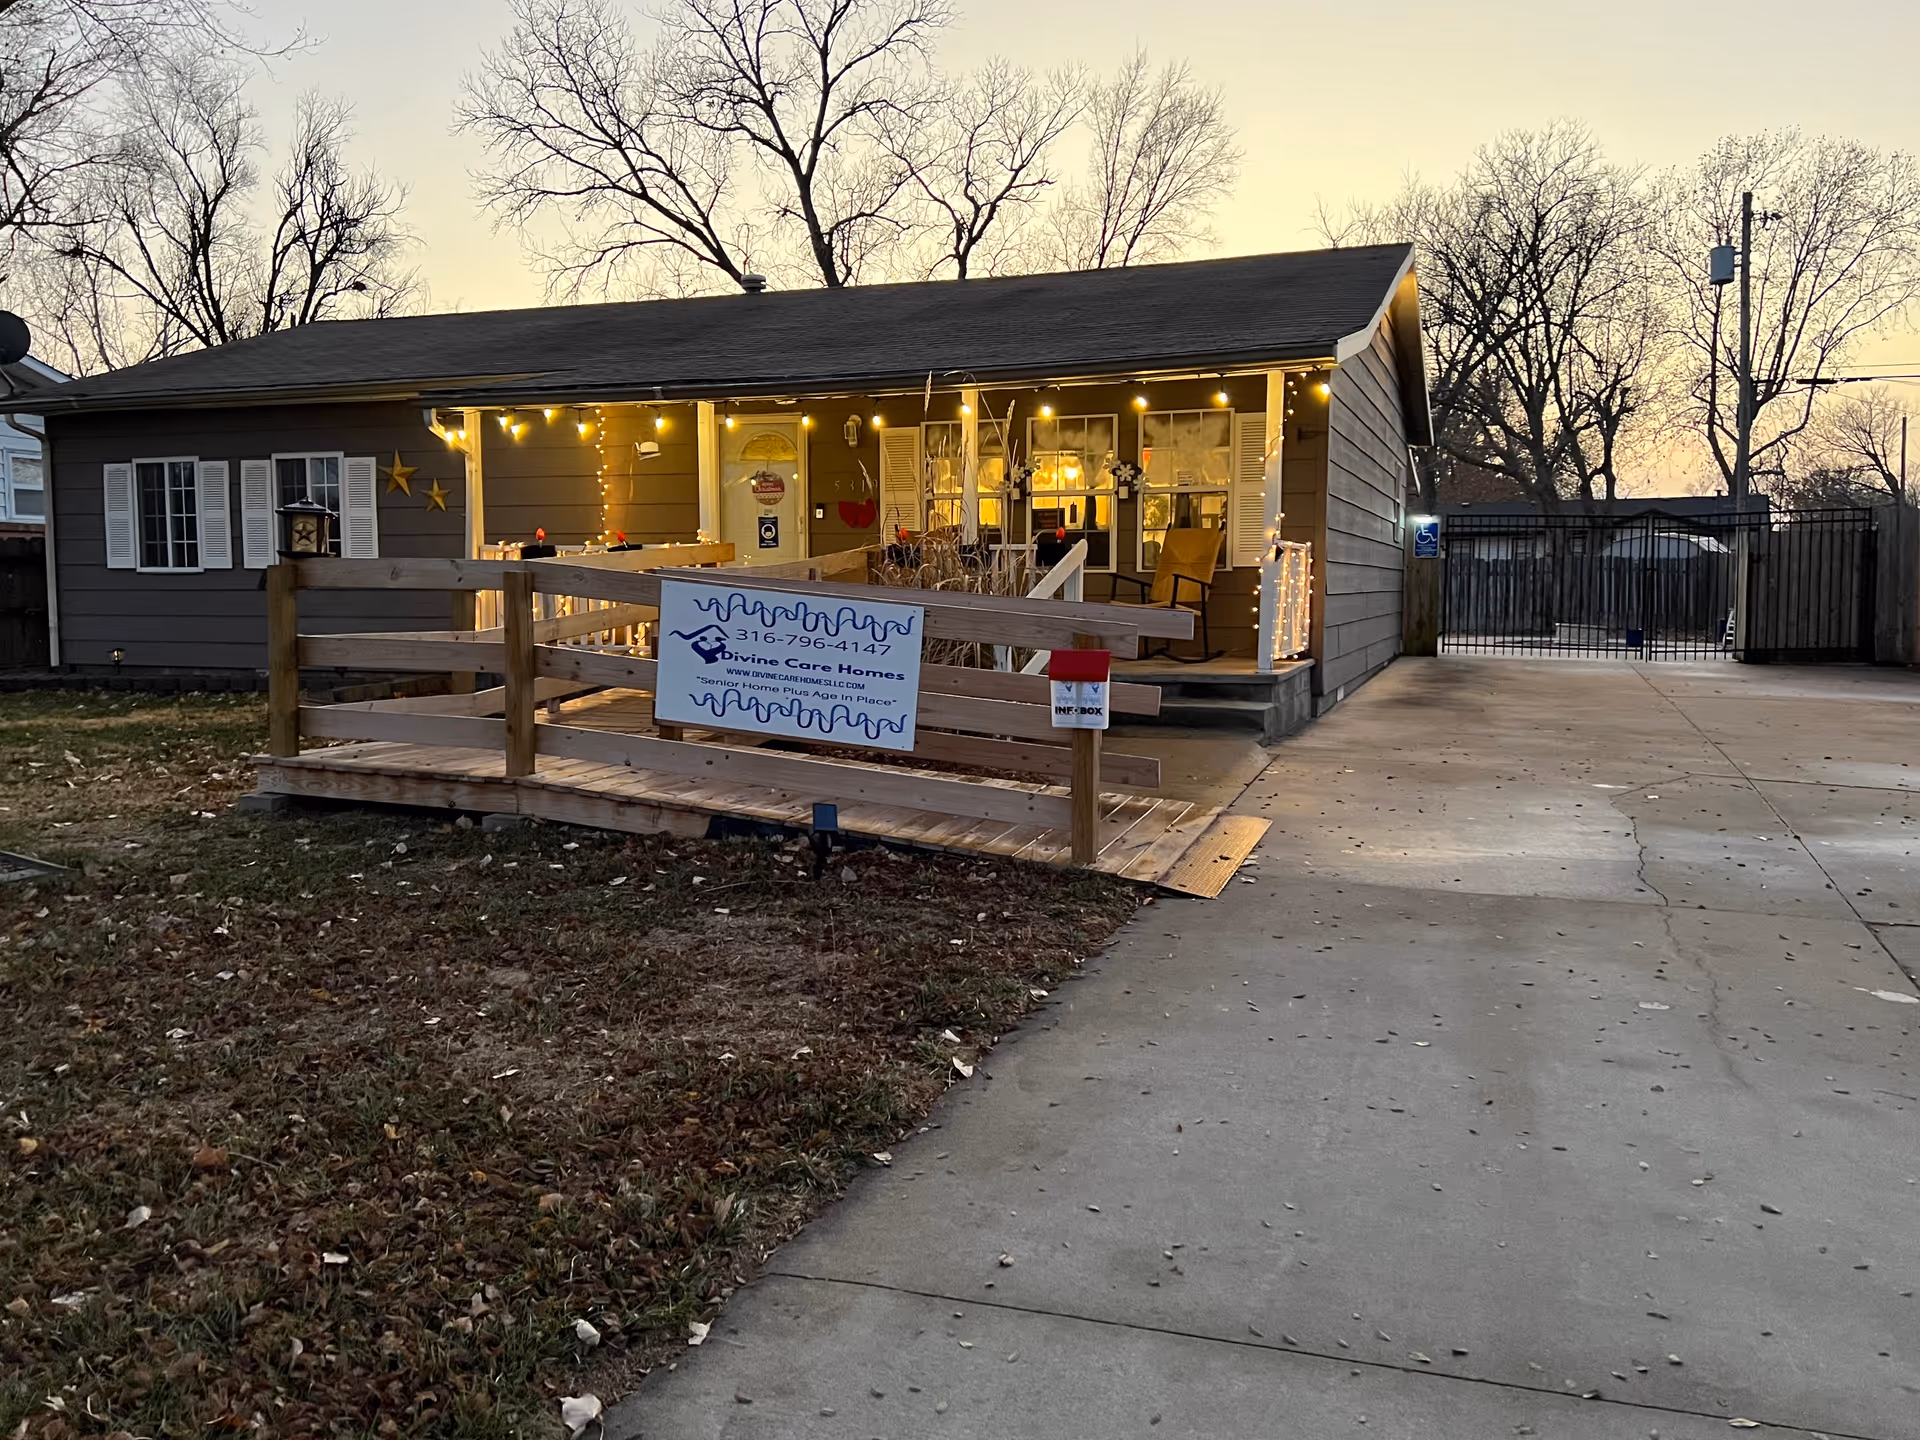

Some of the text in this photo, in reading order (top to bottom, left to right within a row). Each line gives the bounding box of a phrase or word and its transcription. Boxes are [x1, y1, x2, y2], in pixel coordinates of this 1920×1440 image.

[736, 628, 891, 656] 316-796-4147
[721, 650, 905, 681] Divine Care Homes
[726, 668, 866, 690] WWW.DIVINECAREHOMESLLC.COM
[742, 682, 780, 693] Home
[783, 687, 809, 697] Plus
[812, 690, 838, 700] Age
